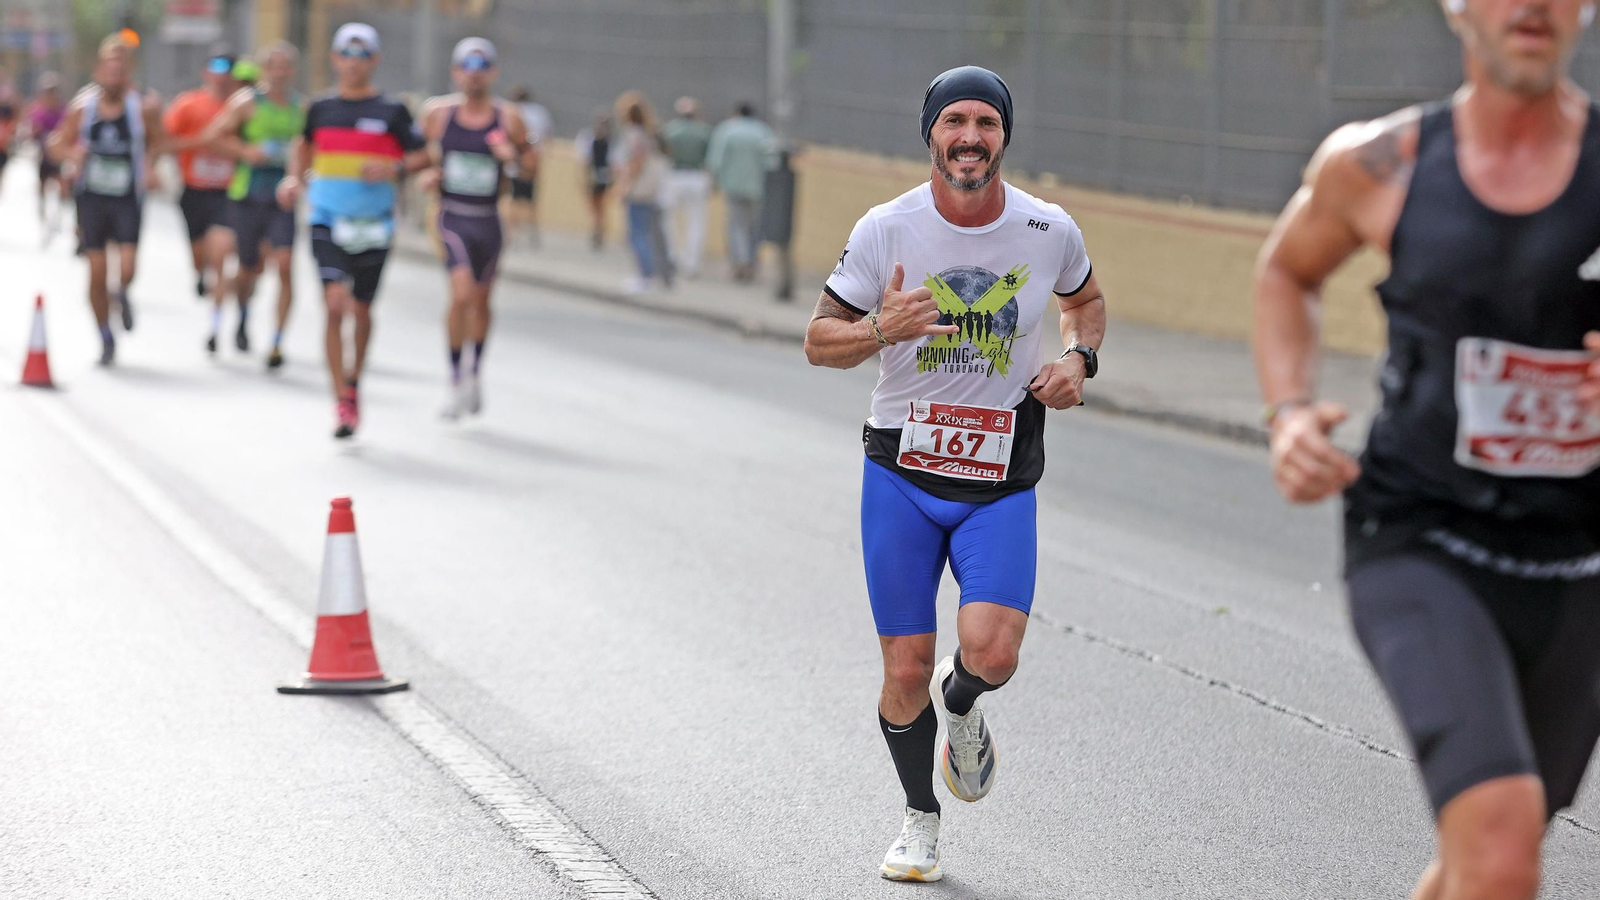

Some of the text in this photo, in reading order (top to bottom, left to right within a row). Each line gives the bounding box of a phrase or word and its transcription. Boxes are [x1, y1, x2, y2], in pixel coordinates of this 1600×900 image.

[916, 345, 969, 364] RUNNING
[923, 362, 938, 373] LOS
[930, 428, 985, 457] 167
